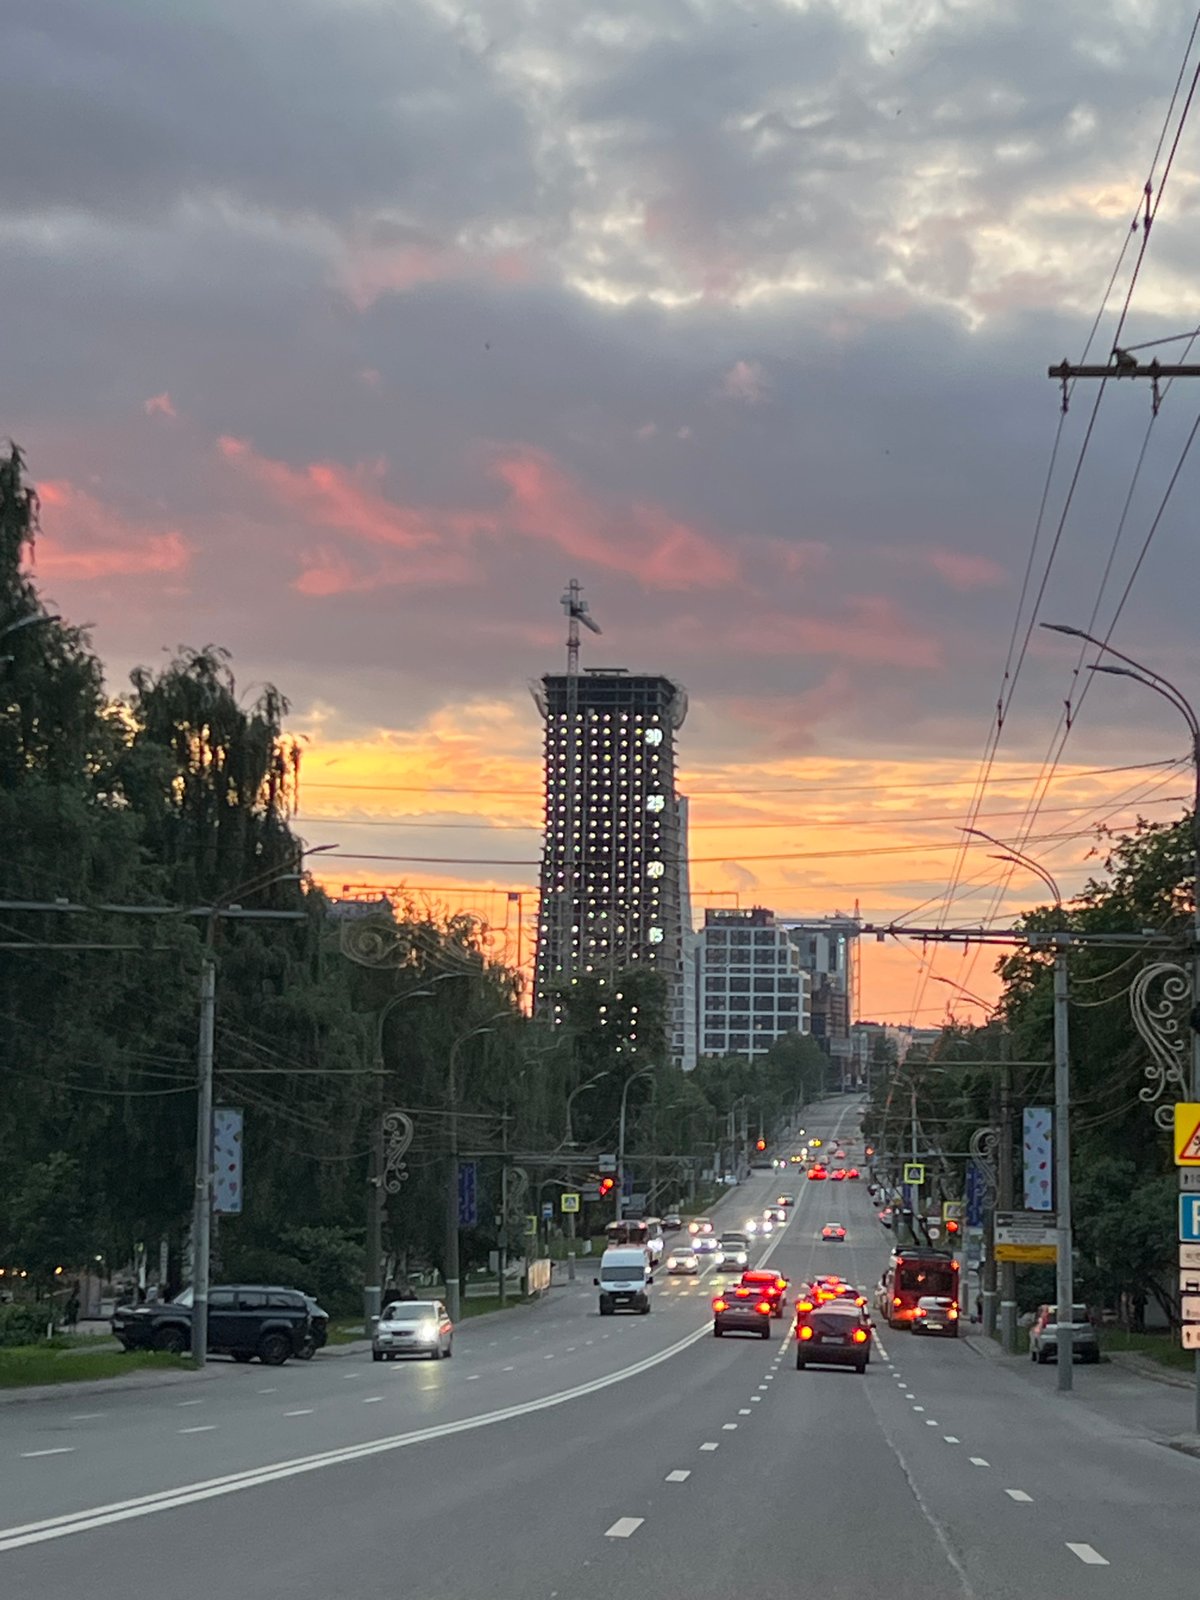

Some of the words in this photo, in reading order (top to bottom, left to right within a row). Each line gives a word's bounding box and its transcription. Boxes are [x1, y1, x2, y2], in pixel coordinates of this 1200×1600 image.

[645, 728, 662, 744] 30
[647, 794, 664, 811] 25
[646, 861, 664, 877] 20
